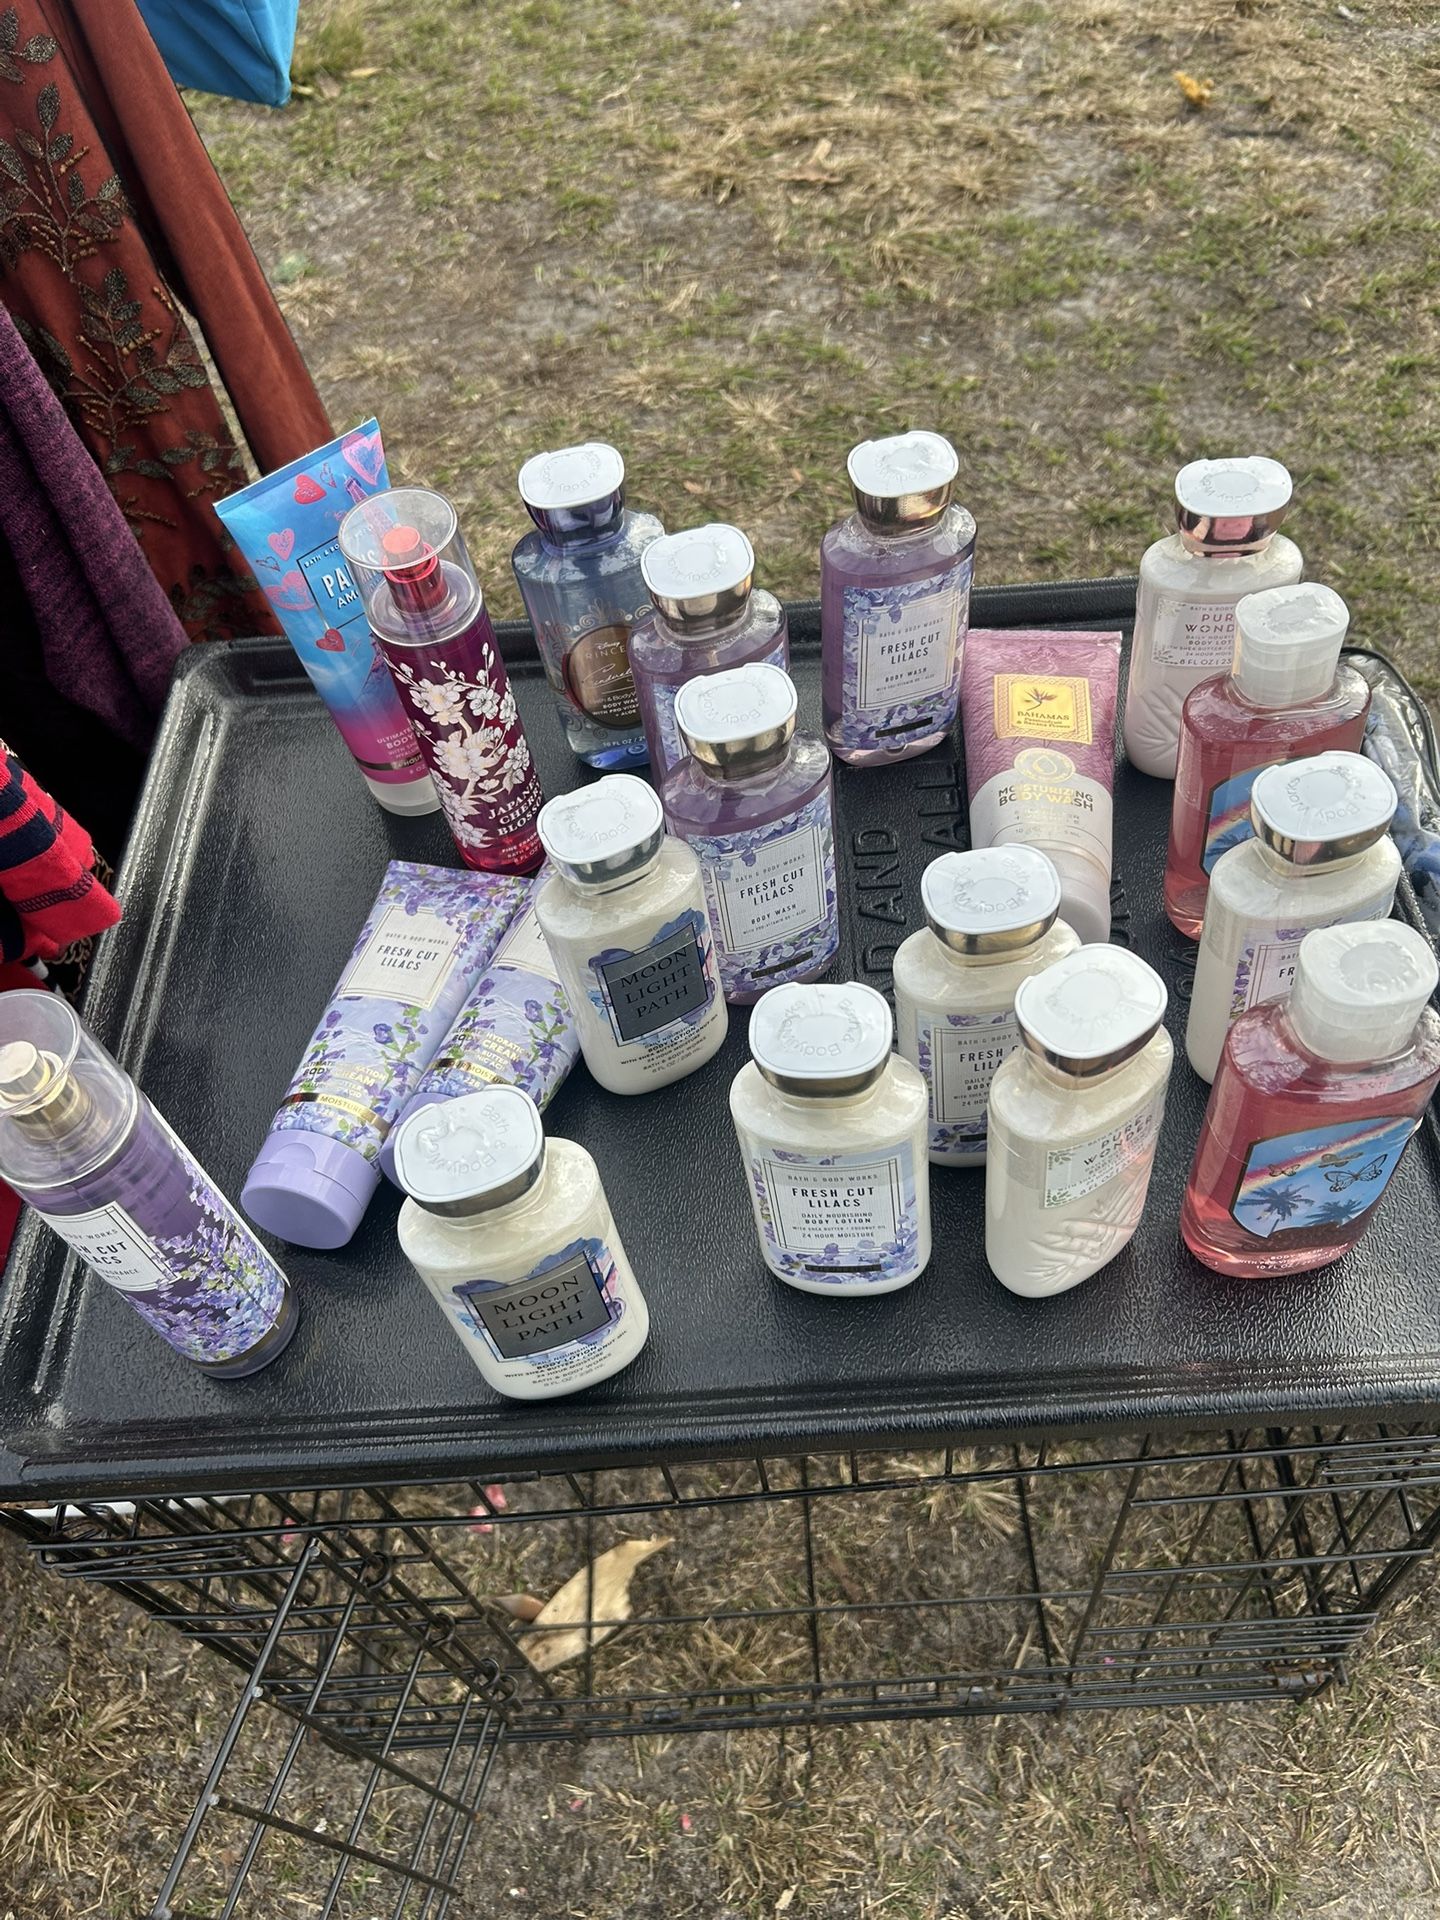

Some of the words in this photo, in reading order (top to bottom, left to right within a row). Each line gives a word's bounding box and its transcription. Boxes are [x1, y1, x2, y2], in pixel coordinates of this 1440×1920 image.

[1201, 613, 1234, 622] PUR
[1185, 624, 1235, 633] WOND
[881, 639, 915, 656] FRESH
[920, 631, 941, 646] CUT
[891, 647, 930, 665] LILACS
[885, 672, 904, 683] BODY
[907, 667, 928, 677] WASH
[602, 702, 622, 710] BODY
[1017, 711, 1070, 720] BAHAMAS
[377, 727, 412, 744] ULTIMATE
[386, 733, 414, 750] BODY
[488, 774, 537, 820] JAPANE
[1315, 803, 1362, 826] Body
[735, 874, 753, 884] BATH
[763, 864, 780, 875] BODY
[783, 853, 806, 867] WORKS
[740, 878, 776, 900] FRESH
[783, 867, 805, 884] CUT
[853, 829, 907, 926] AND
[753, 884, 795, 907] LILACS
[751, 914, 771, 926] BODY
[774, 903, 797, 916] WASH
[377, 944, 413, 958] FRESH
[416, 950, 440, 961] CUT
[380, 957, 422, 971] LILACS
[620, 946, 689, 989] MOON
[625, 963, 691, 1005] LIGHT
[636, 985, 689, 1019] PATH
[648, 1042, 668, 1053] BODY
[670, 1026, 698, 1044] LOTION
[991, 1033, 1012, 1042] BODY
[482, 1039, 521, 1063] CREAM
[960, 1047, 1004, 1063] FRESH
[469, 1064, 504, 1085] MOISTUR
[974, 1059, 1003, 1073] LILA
[964, 1078, 985, 1086] DAILY
[967, 1082, 992, 1091] BODY
[974, 1098, 989, 1106] HOU
[480, 1104, 511, 1136] Bath
[1084, 1113, 1154, 1166] WONDER
[1101, 1114, 1143, 1150] PURE
[848, 1174, 878, 1182] WORKS
[792, 1187, 838, 1198] FRESH
[847, 1186, 875, 1197] CUT
[809, 1198, 861, 1208] LILACS
[86, 1229, 118, 1240] WORKS
[838, 1231, 875, 1239] MOISTURE
[96, 1241, 129, 1256] CUT
[1271, 1253, 1296, 1261] BODY
[493, 1275, 580, 1315] MOON
[502, 1290, 585, 1329] LIGHT
[518, 1310, 584, 1341] PATH
[536, 1359, 562, 1371] BODY
[563, 1345, 598, 1362] LOTION
